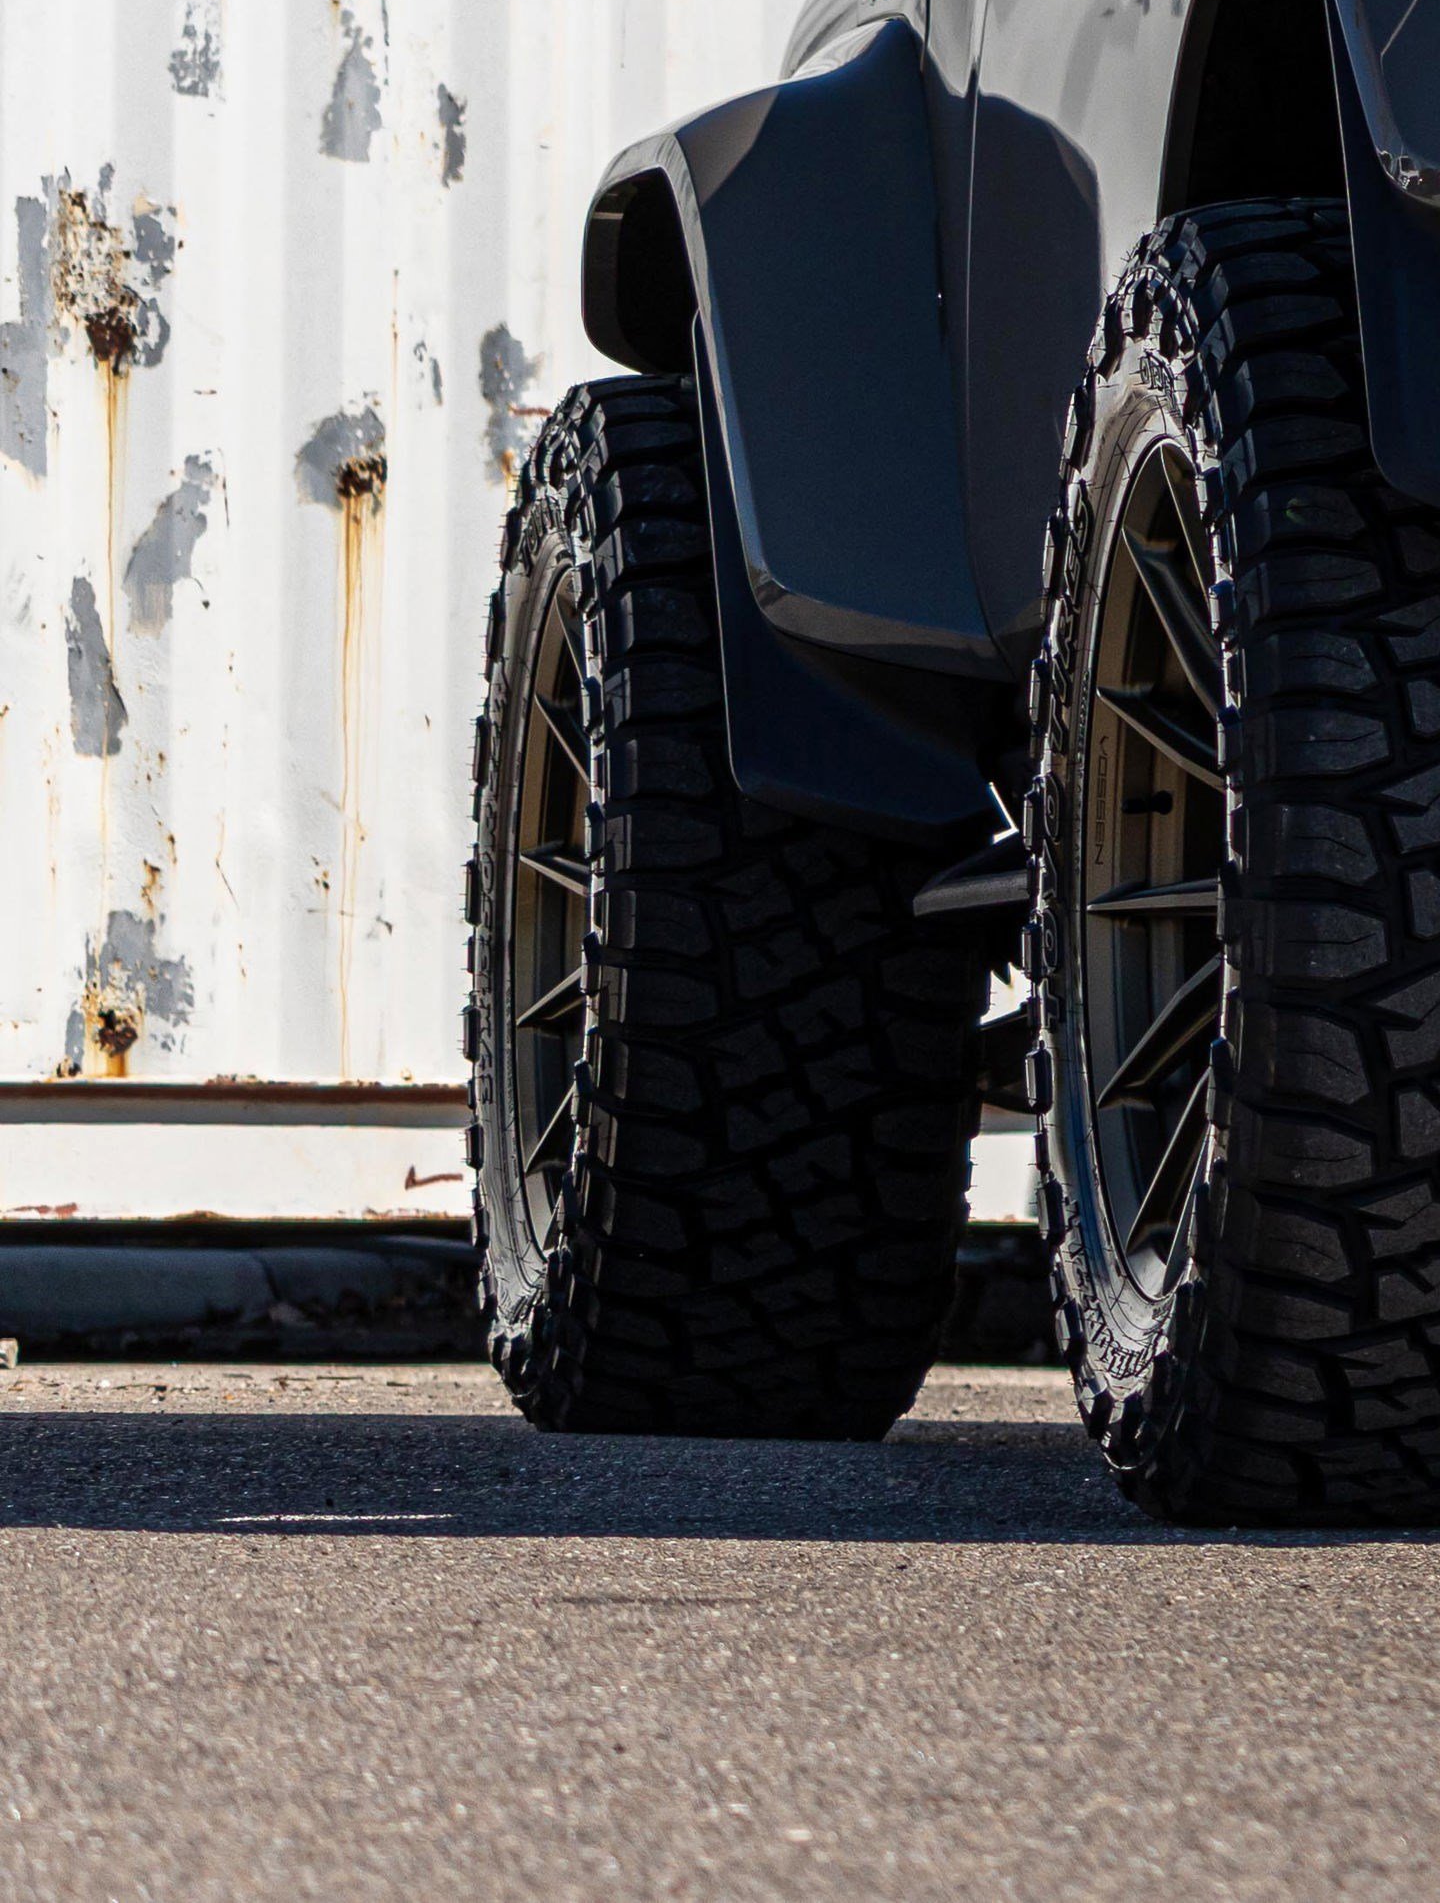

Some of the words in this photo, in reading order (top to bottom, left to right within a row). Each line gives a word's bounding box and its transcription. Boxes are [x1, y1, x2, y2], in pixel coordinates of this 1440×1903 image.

[1045, 478, 1092, 758] TIRES
[1039, 772, 1065, 1029] TOYO
[1094, 734, 1111, 866] VOSSEN
